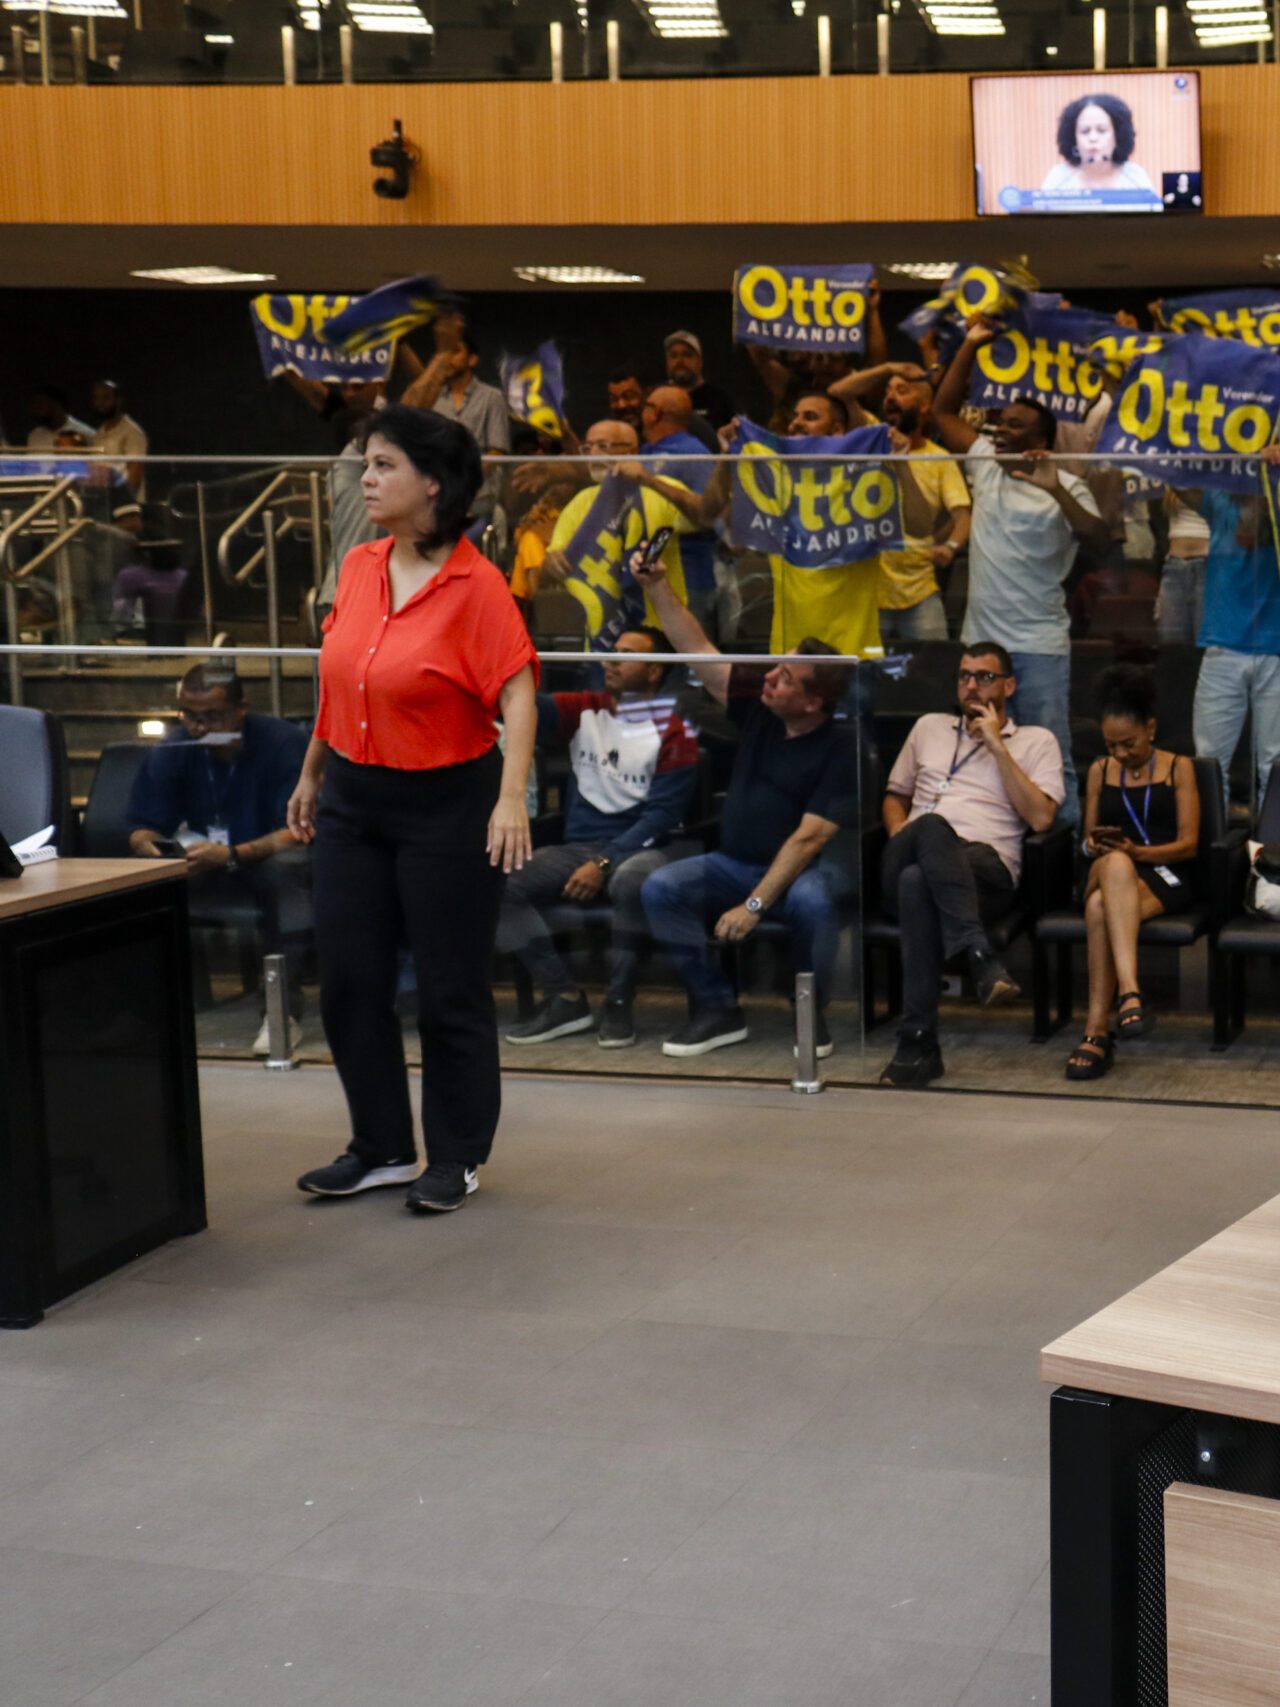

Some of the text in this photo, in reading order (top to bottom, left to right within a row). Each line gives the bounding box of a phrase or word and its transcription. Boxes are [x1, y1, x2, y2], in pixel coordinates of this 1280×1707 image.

[739, 265, 865, 327] Otto
[747, 320, 861, 342] ALEJANDRO
[976, 329, 1103, 399] Otto
[1118, 368, 1271, 454] Otto
[737, 441, 895, 531] Otto
